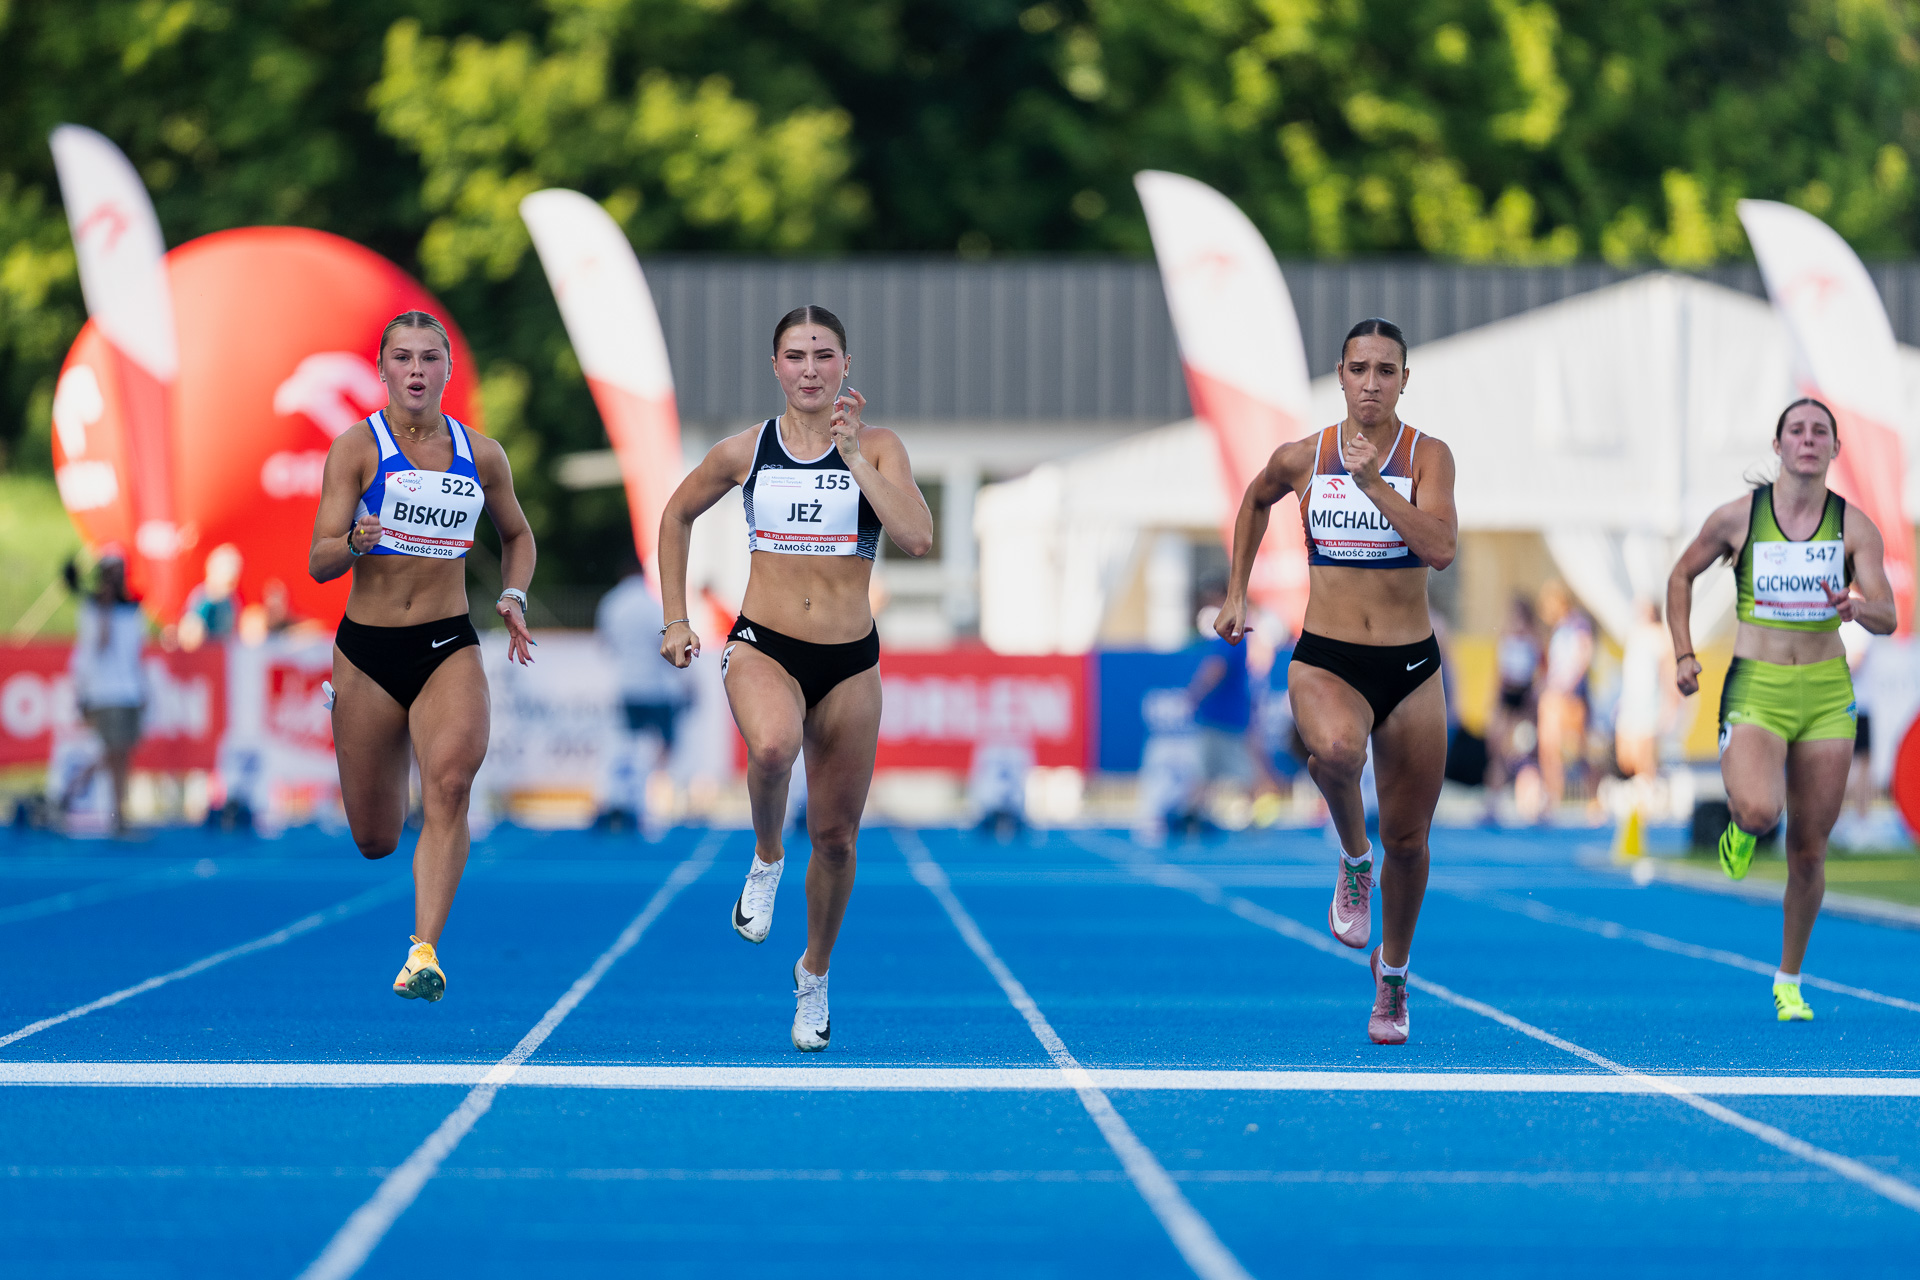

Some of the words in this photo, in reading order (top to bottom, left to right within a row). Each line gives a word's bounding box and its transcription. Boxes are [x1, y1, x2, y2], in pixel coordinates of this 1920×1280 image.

[441, 477, 476, 497] 522
[815, 474, 850, 490] 155
[393, 502, 468, 529] BISKUP
[787, 499, 823, 523] JEŻ
[1312, 510, 1396, 531] MICHALU
[785, 534, 818, 542] Mistrzostwa
[1338, 540, 1370, 548] Mistrzostwa
[394, 541, 432, 554] ZAMOŚĆ
[432, 548, 453, 556] 2026
[773, 542, 812, 552] ZAMOŚĆ
[1806, 546, 1837, 562] 547
